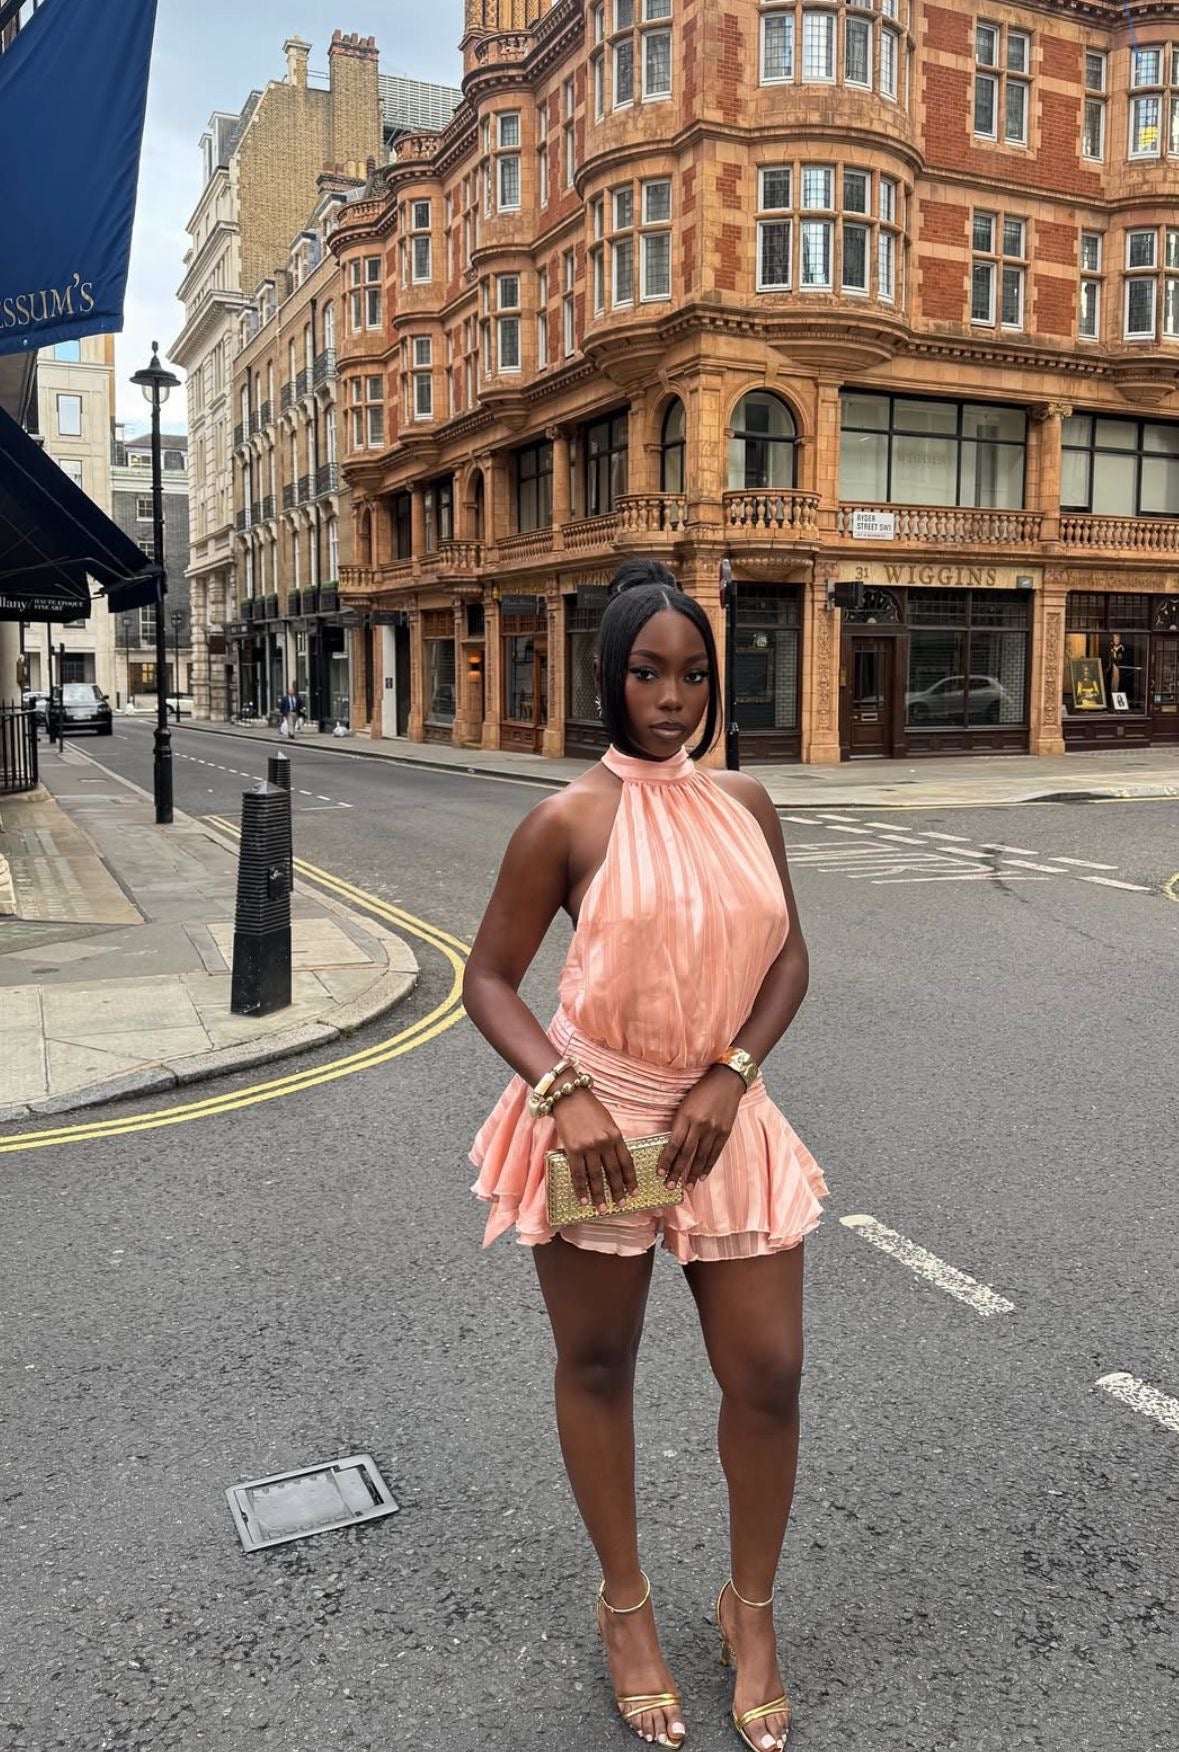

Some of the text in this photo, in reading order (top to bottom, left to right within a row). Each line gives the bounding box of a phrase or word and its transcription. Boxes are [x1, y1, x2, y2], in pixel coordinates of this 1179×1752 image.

[856, 522, 878, 531] STREET
[855, 564, 997, 586] 31 WIGGINS
